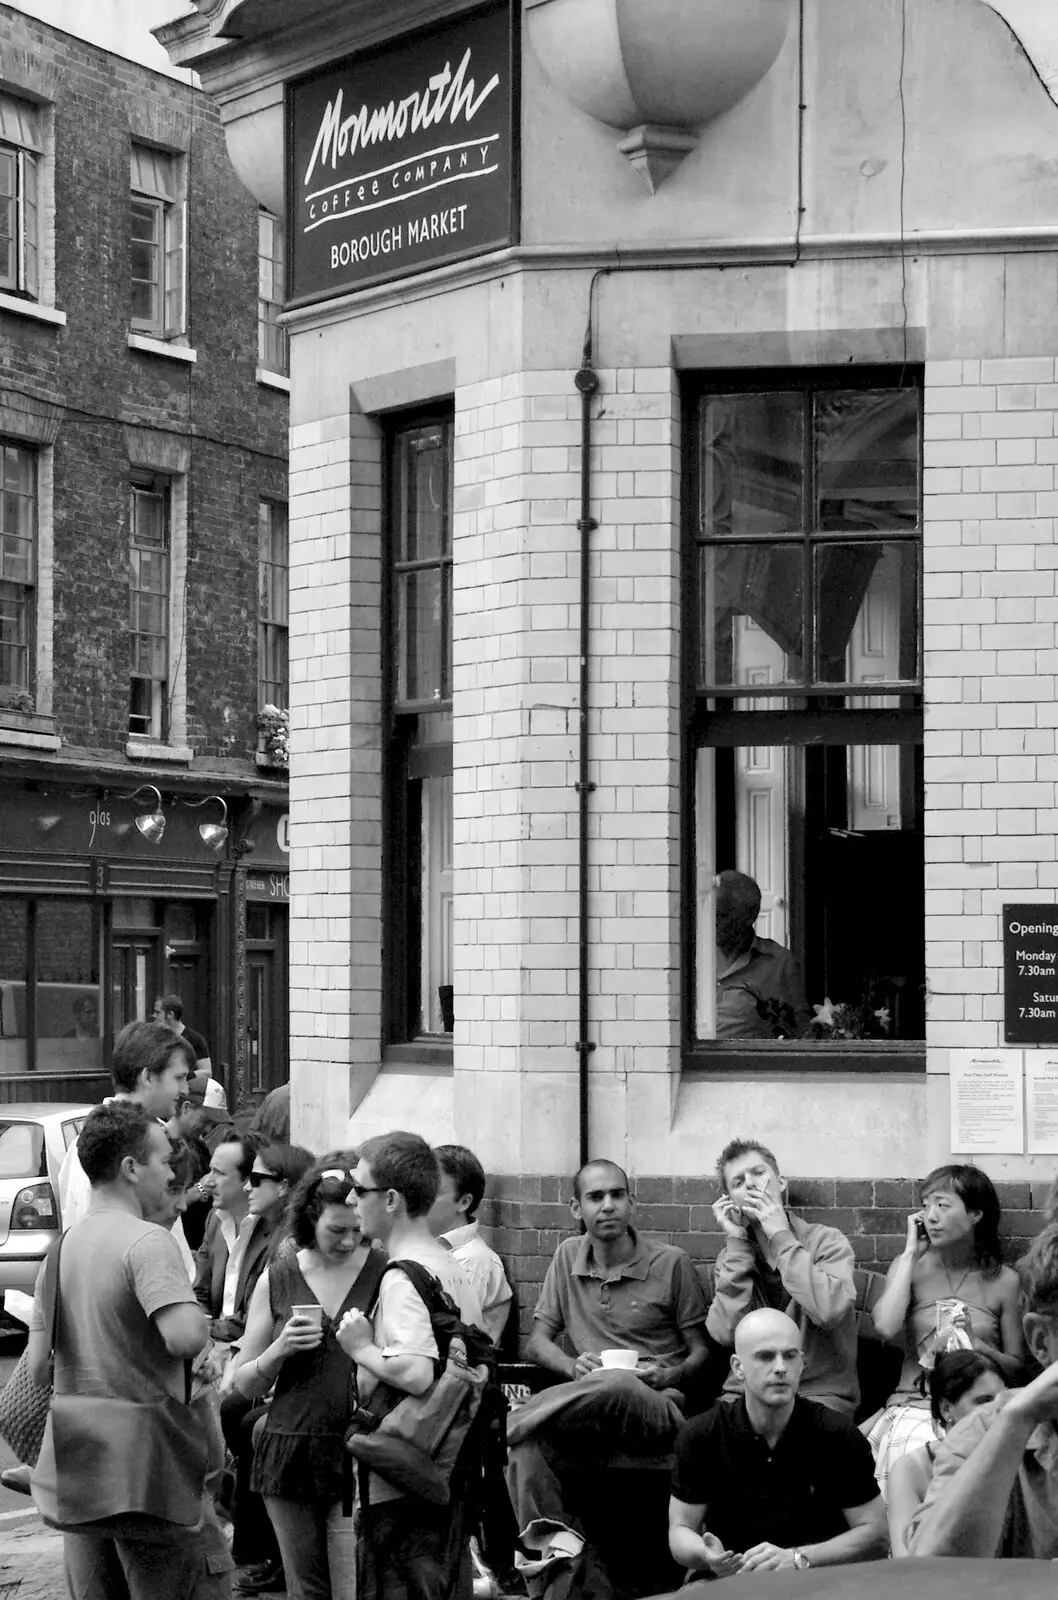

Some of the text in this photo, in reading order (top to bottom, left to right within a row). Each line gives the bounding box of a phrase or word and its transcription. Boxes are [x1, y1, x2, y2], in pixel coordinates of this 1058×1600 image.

[304, 47, 499, 185] Monmouth
[331, 204, 467, 269] BOROUGH MARKET
[88, 800, 111, 847] glas
[1009, 921, 1058, 937] Opening
[1016, 950, 1056, 963] Monday
[1018, 965, 1055, 976] 7.30am
[1019, 1007, 1056, 1018] 7.30am
